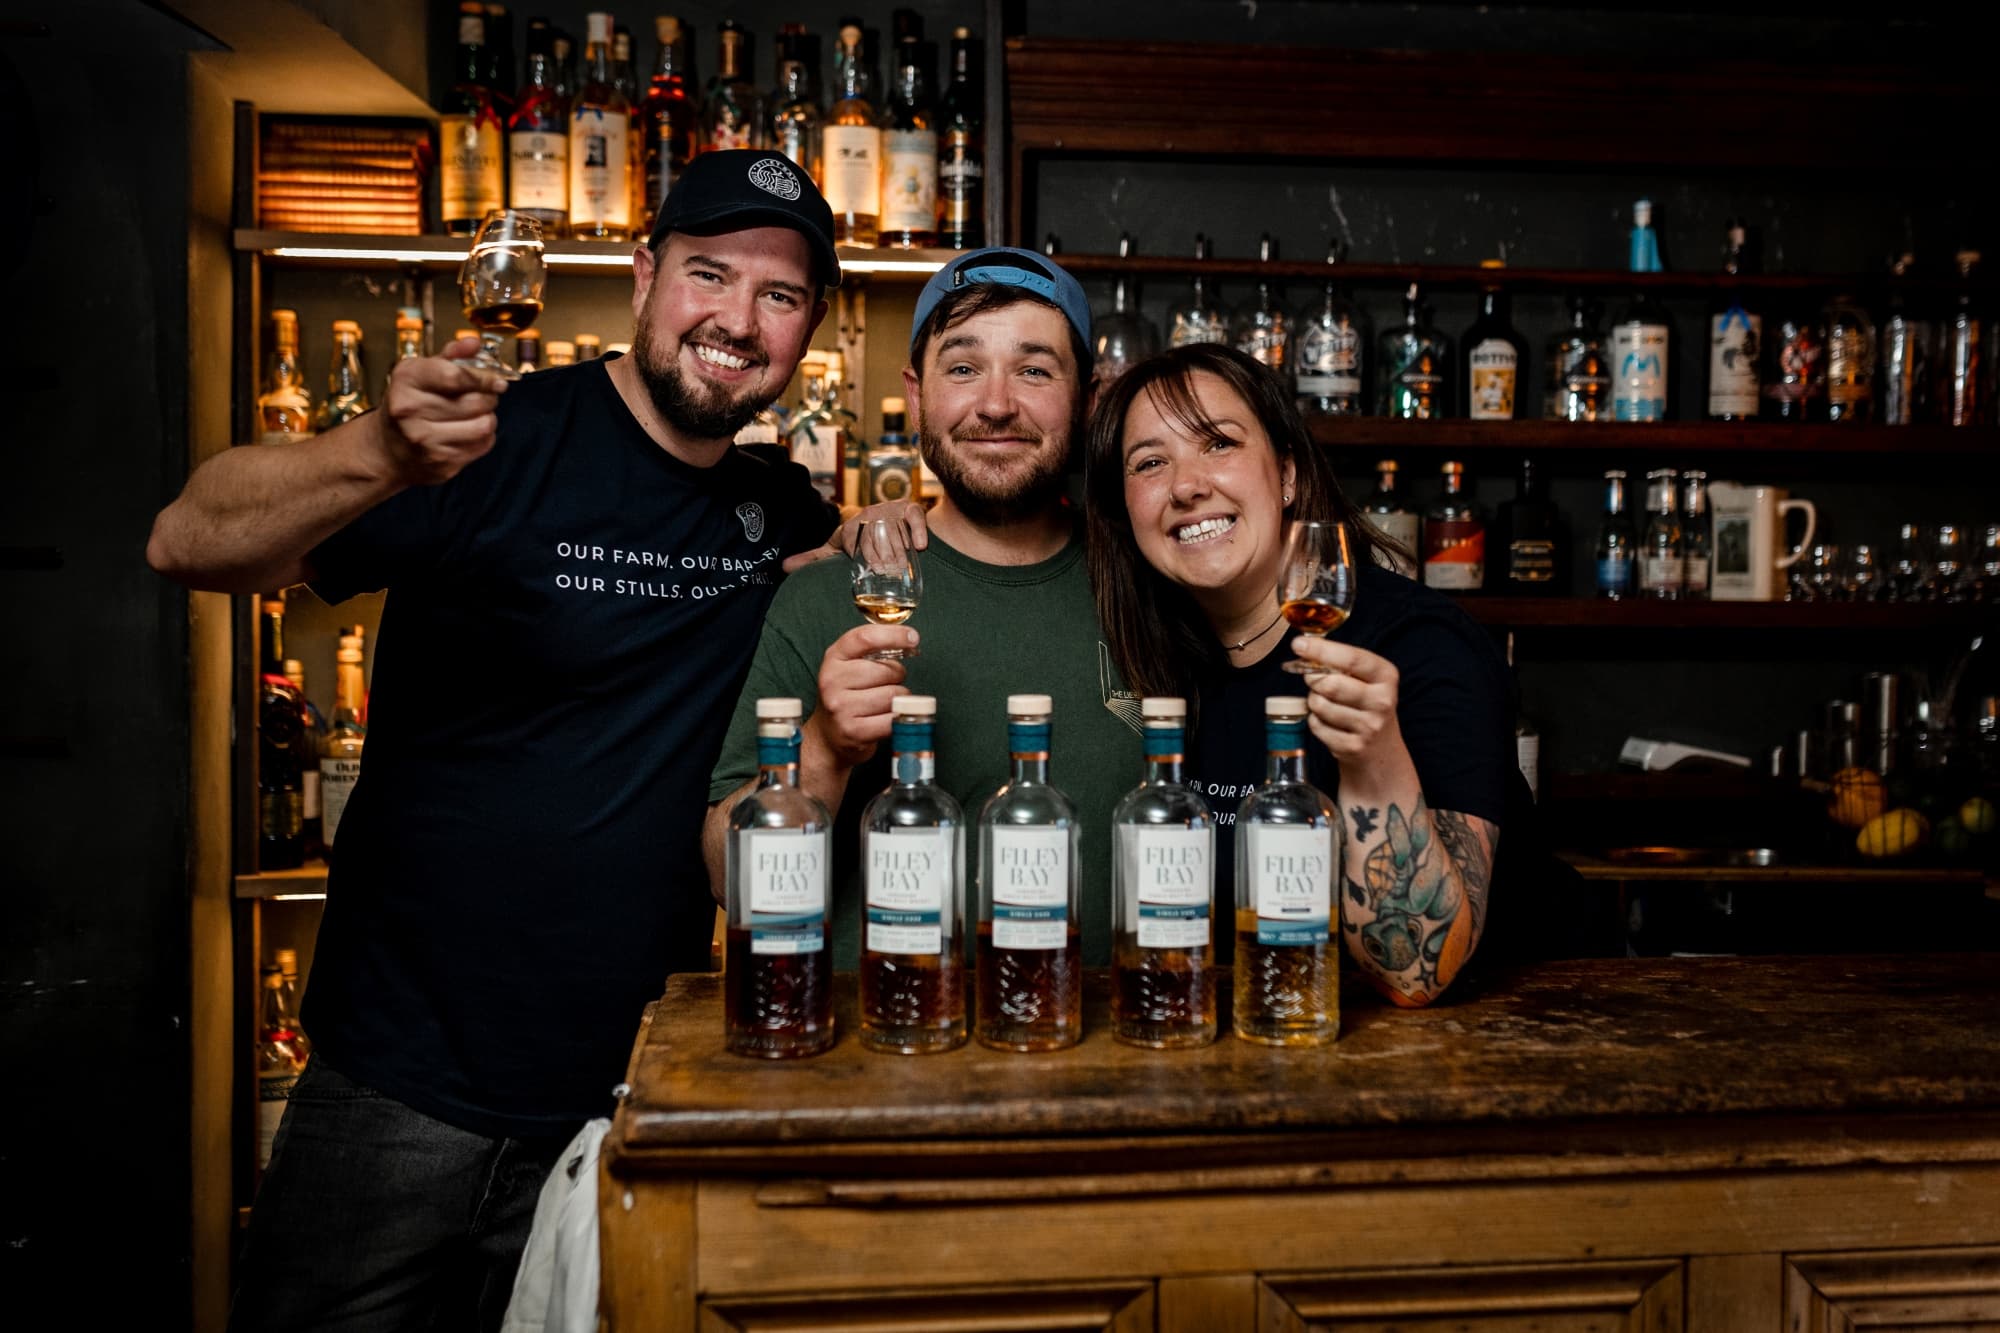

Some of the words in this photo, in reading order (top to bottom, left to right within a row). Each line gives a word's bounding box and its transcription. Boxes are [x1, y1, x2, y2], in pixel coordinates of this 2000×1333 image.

[557, 542, 604, 561] OUR
[613, 549, 674, 569] FARM.
[681, 555, 718, 571] OUR
[556, 574, 605, 592] OUR
[615, 579, 684, 599] STILLS.
[1208, 783, 1237, 798] OUR
[759, 852, 820, 872] FILEY
[873, 850, 935, 870] FILEY
[1001, 847, 1062, 866] FILEY
[1146, 847, 1205, 866] FILEY
[1266, 855, 1326, 874] FILEY
[768, 873, 811, 892] BAY
[882, 871, 924, 890] BAY
[1010, 867, 1052, 886] BAY
[1156, 867, 1197, 885] BAY
[1276, 875, 1317, 893] BAY
